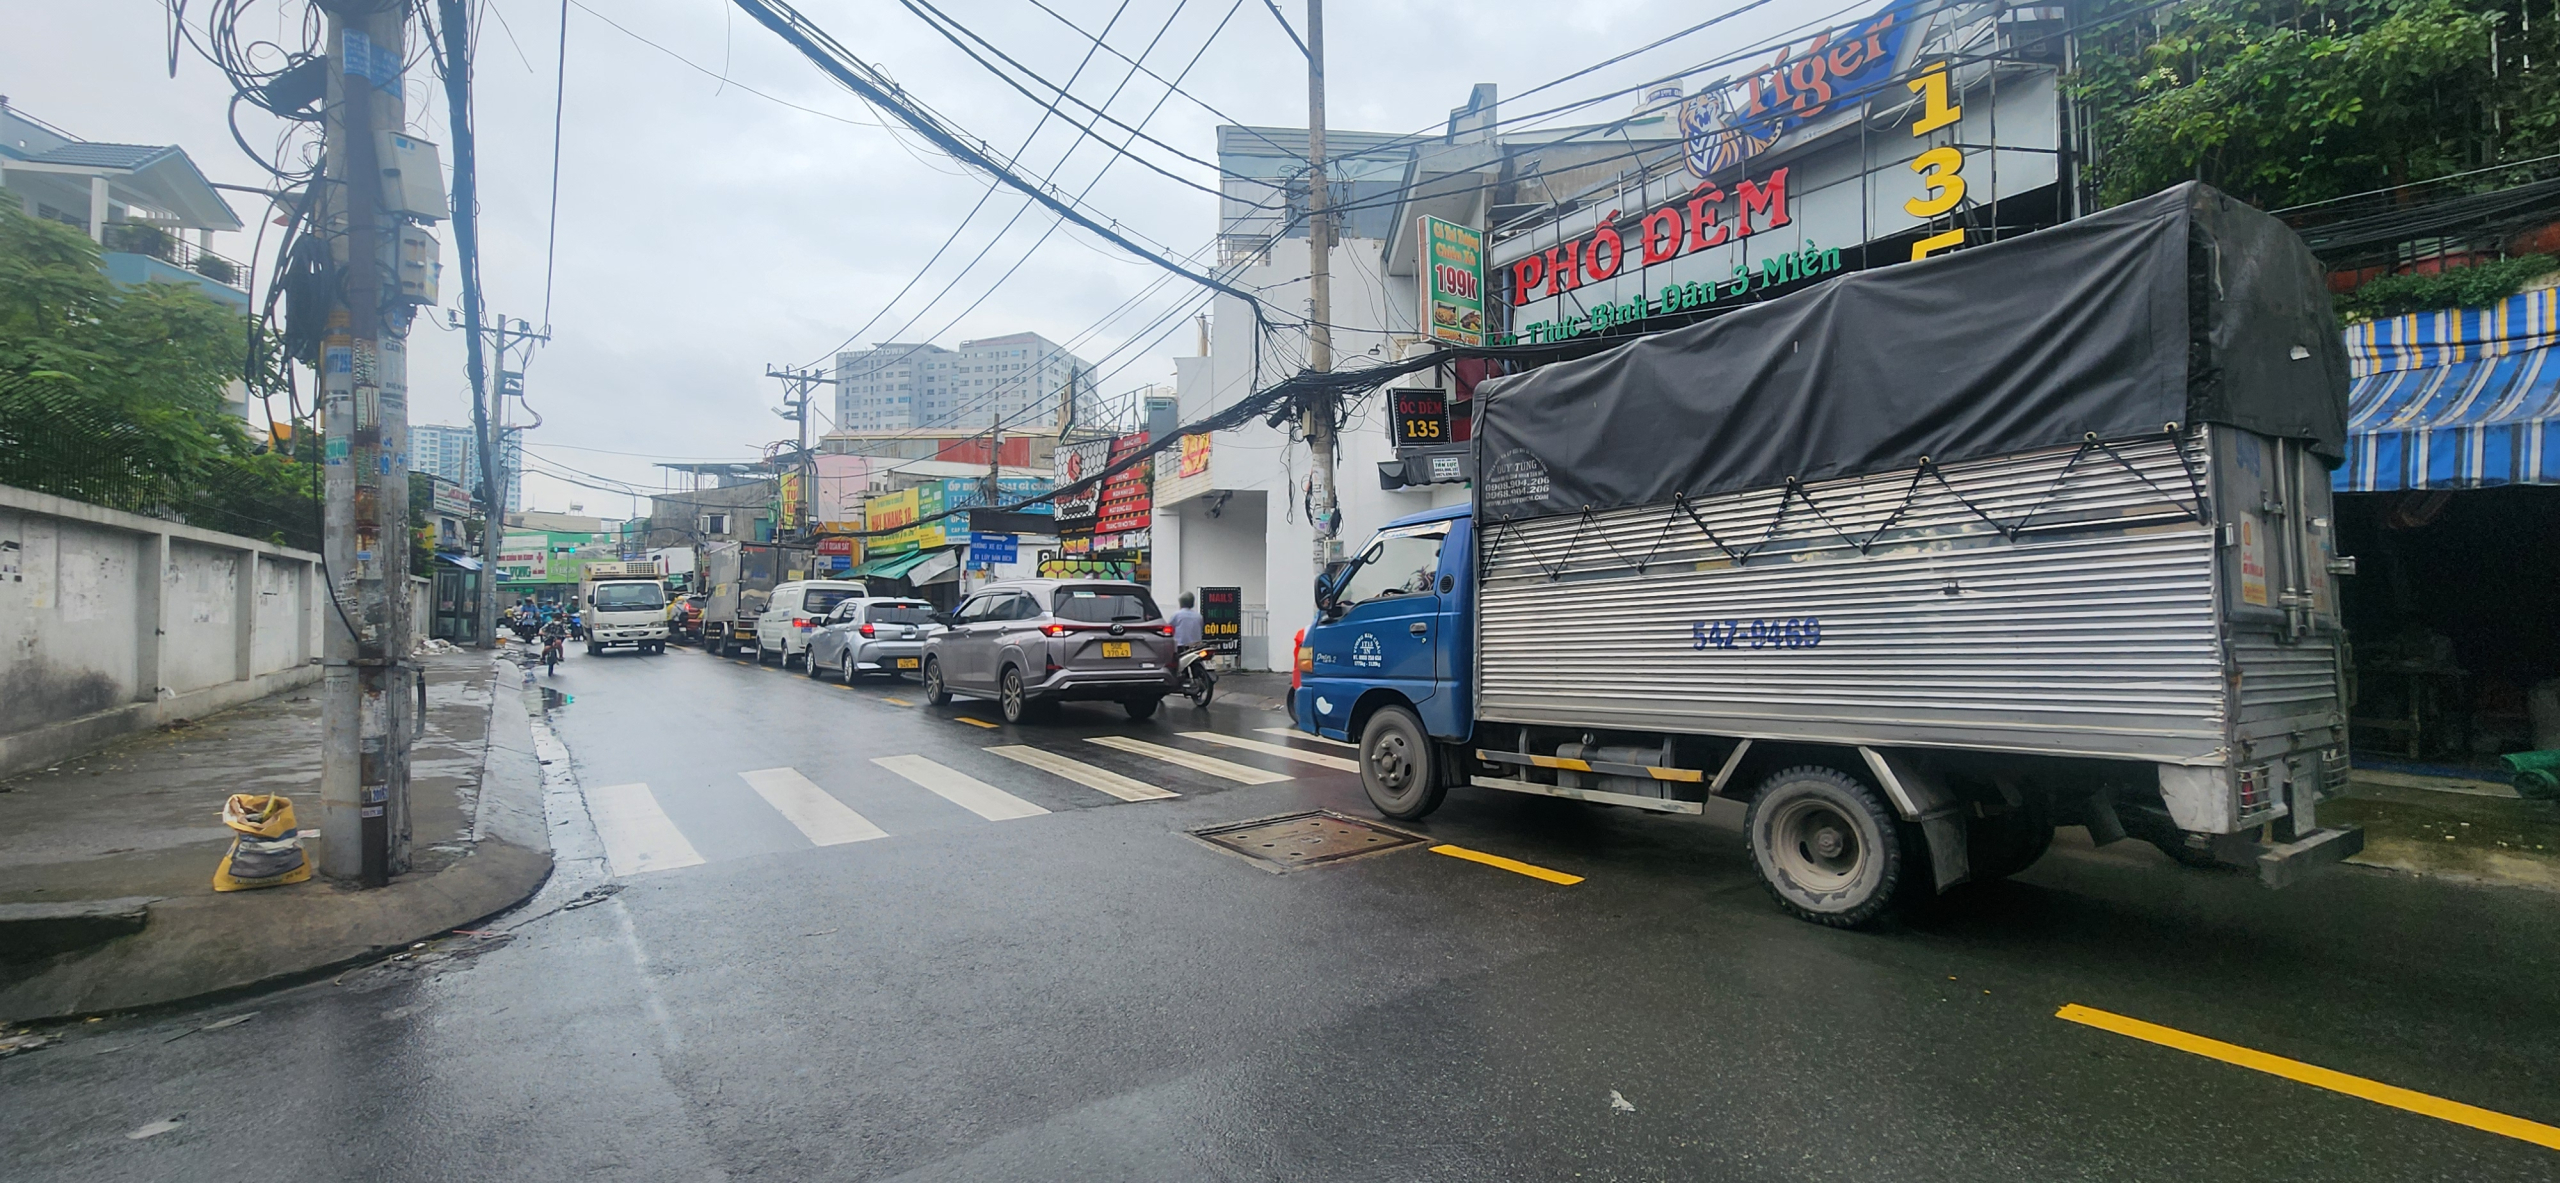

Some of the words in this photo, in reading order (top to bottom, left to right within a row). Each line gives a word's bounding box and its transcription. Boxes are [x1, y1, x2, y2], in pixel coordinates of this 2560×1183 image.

[1736, 13, 1894, 117] Tiger
[1513, 208, 1625, 306] PHỐ
[1640, 166, 1793, 267] ĐÊM
[1435, 263, 1478, 301] 199k
[1590, 293, 1649, 334] Bình
[1659, 278, 1718, 315] Dân
[1731, 264, 1750, 295] 3
[1761, 238, 1843, 289] Miền
[1400, 395, 1416, 414] ỐC
[1406, 420, 1440, 438] 135
[1485, 476, 1551, 492] 0908.904.206
[1208, 593, 1233, 603] NAILS
[1204, 621, 1219, 636] GỘI
